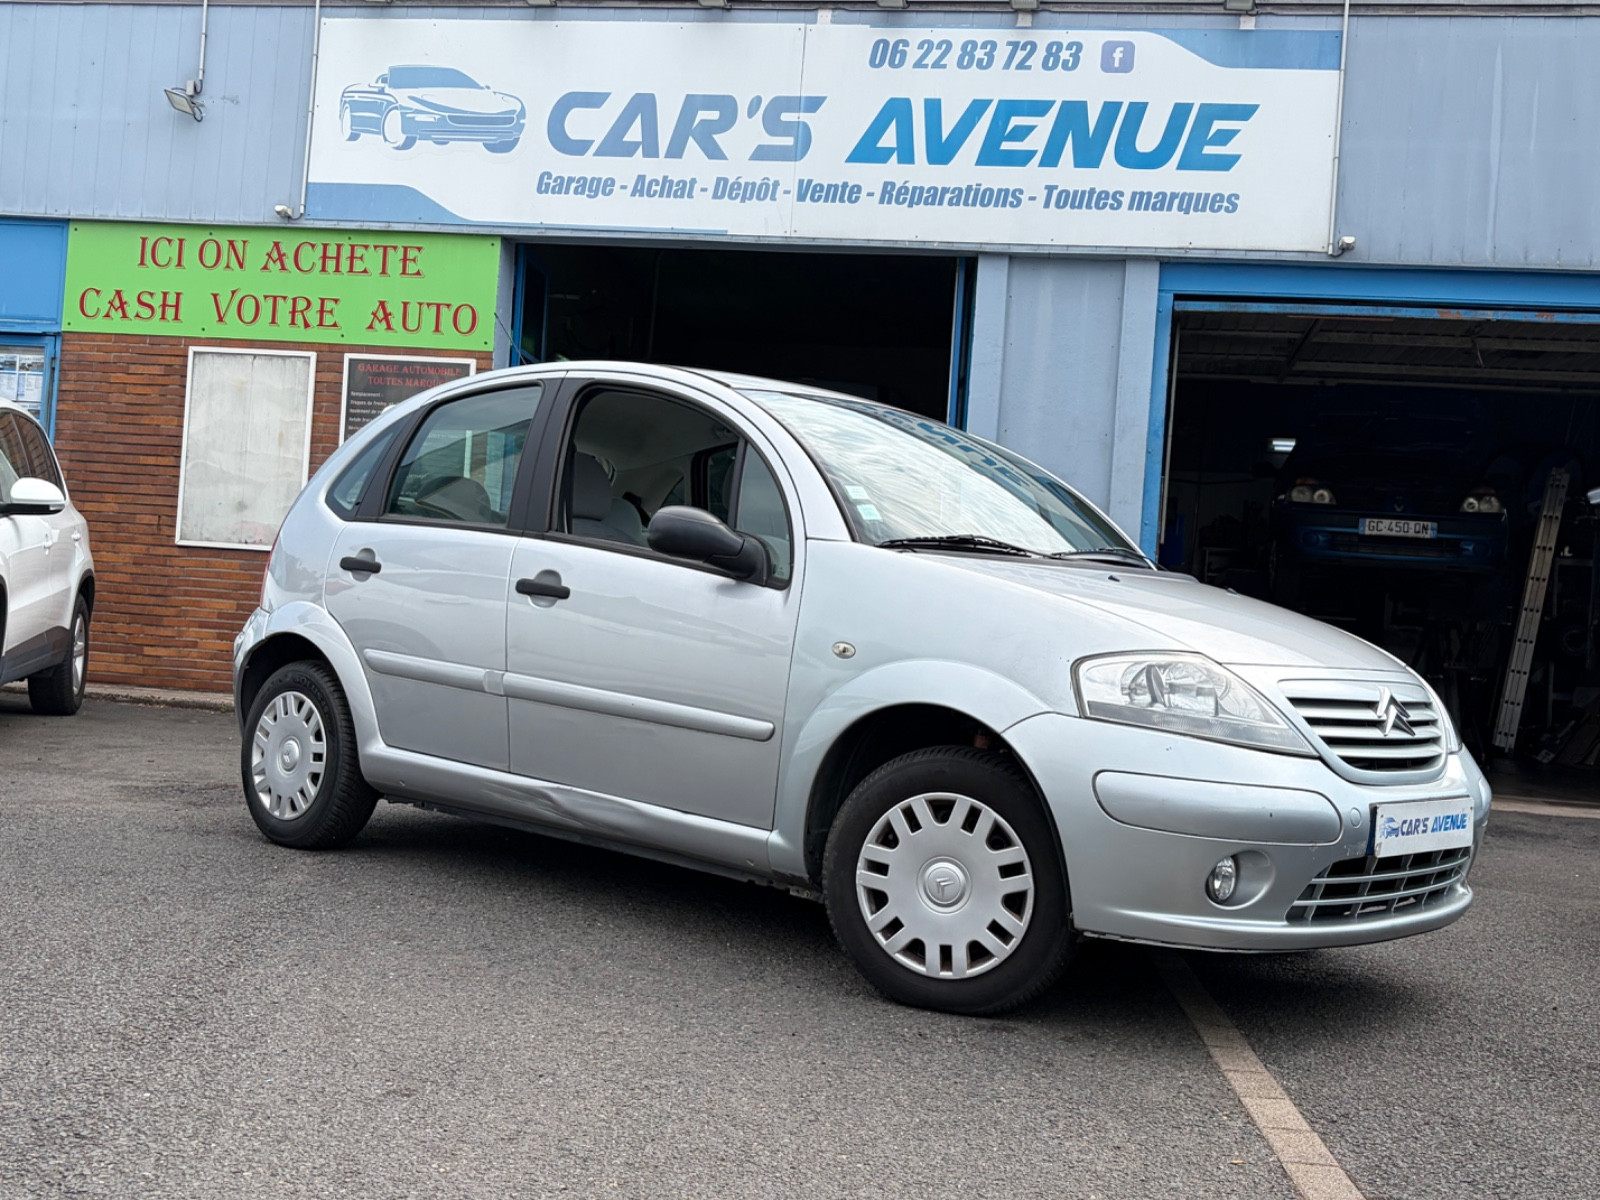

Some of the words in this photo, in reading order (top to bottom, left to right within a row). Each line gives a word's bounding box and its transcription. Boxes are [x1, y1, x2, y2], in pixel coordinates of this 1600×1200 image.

[868, 38, 910, 69] 06
[912, 39, 953, 69] 22
[956, 39, 998, 71] 83
[1002, 40, 1038, 71] 72
[1041, 41, 1084, 72] 83
[546, 91, 828, 161] CAR'S
[844, 97, 1260, 171] AVENUE
[536, 170, 616, 199] Garage
[630, 173, 698, 199] Achat
[711, 175, 780, 203] Dépôt
[796, 178, 863, 205] Vente
[878, 180, 1025, 208] Réparations
[1042, 184, 1125, 211] Toutes
[1127, 189, 1241, 215] marques
[137, 236, 187, 269] ICI
[198, 239, 249, 271] ON
[260, 240, 425, 278] ACHETE
[79, 287, 184, 323] CASH
[211, 287, 342, 330] VOTRE
[366, 300, 479, 335] AUTO
[358, 363, 398, 373] GARAGE
[402, 365, 462, 376] AUTOMOBILE
[368, 376, 402, 385] TOUTES
[1400, 817, 1430, 836] CAR'S
[1431, 814, 1469, 833] AVENUE
